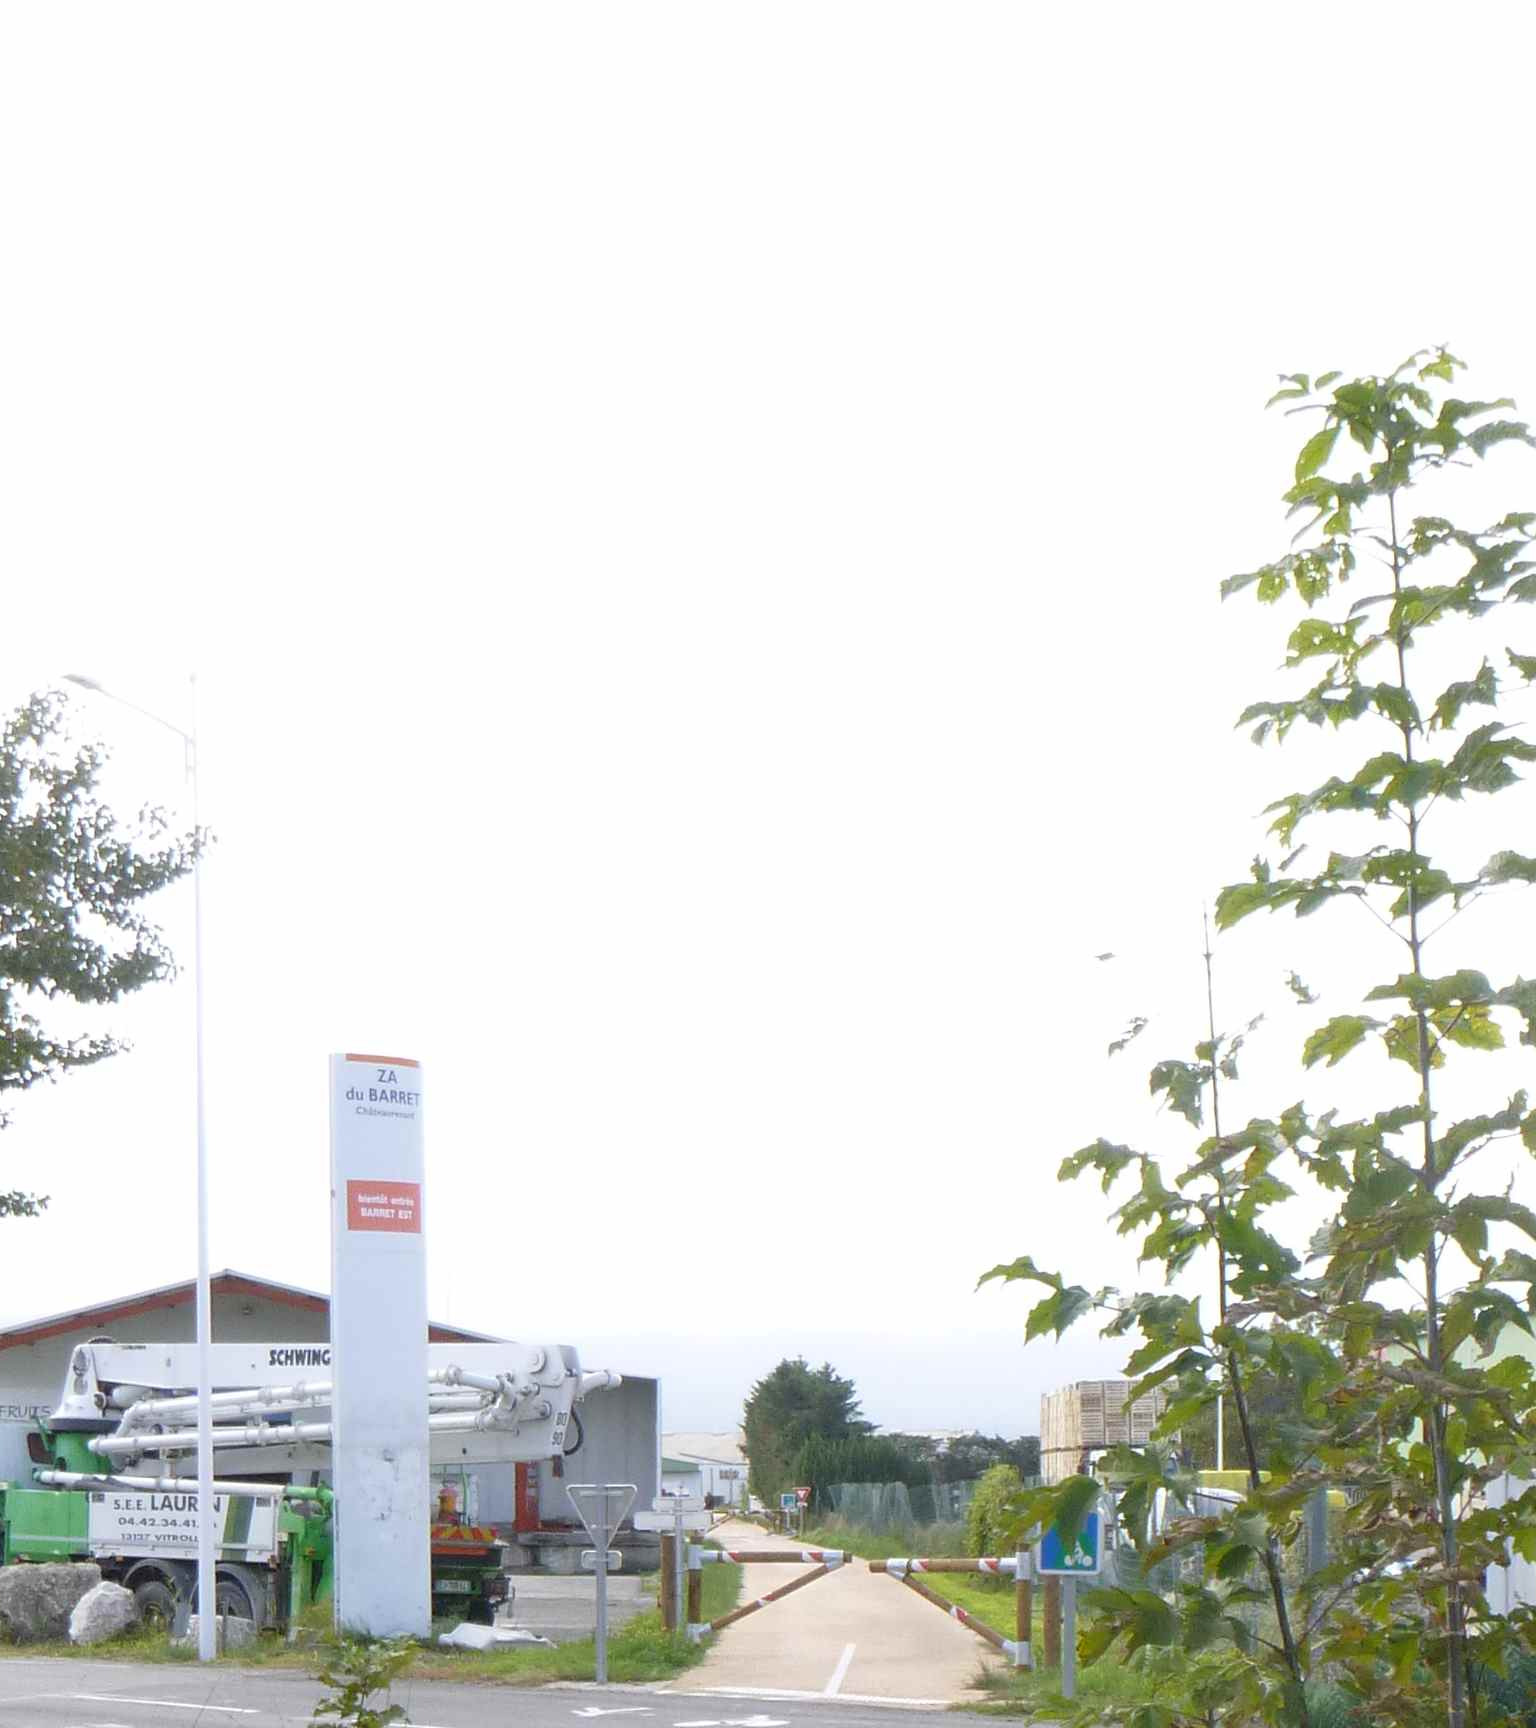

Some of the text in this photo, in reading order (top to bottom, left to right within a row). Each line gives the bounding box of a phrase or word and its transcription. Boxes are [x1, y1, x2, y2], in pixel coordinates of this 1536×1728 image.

[377, 1068, 398, 1084] ZA
[346, 1087, 420, 1107] du BARRET
[269, 1349, 331, 1366] SCHWING
[151, 1495, 221, 1512] LAURN
[154, 1533, 199, 1543] VITROLL
